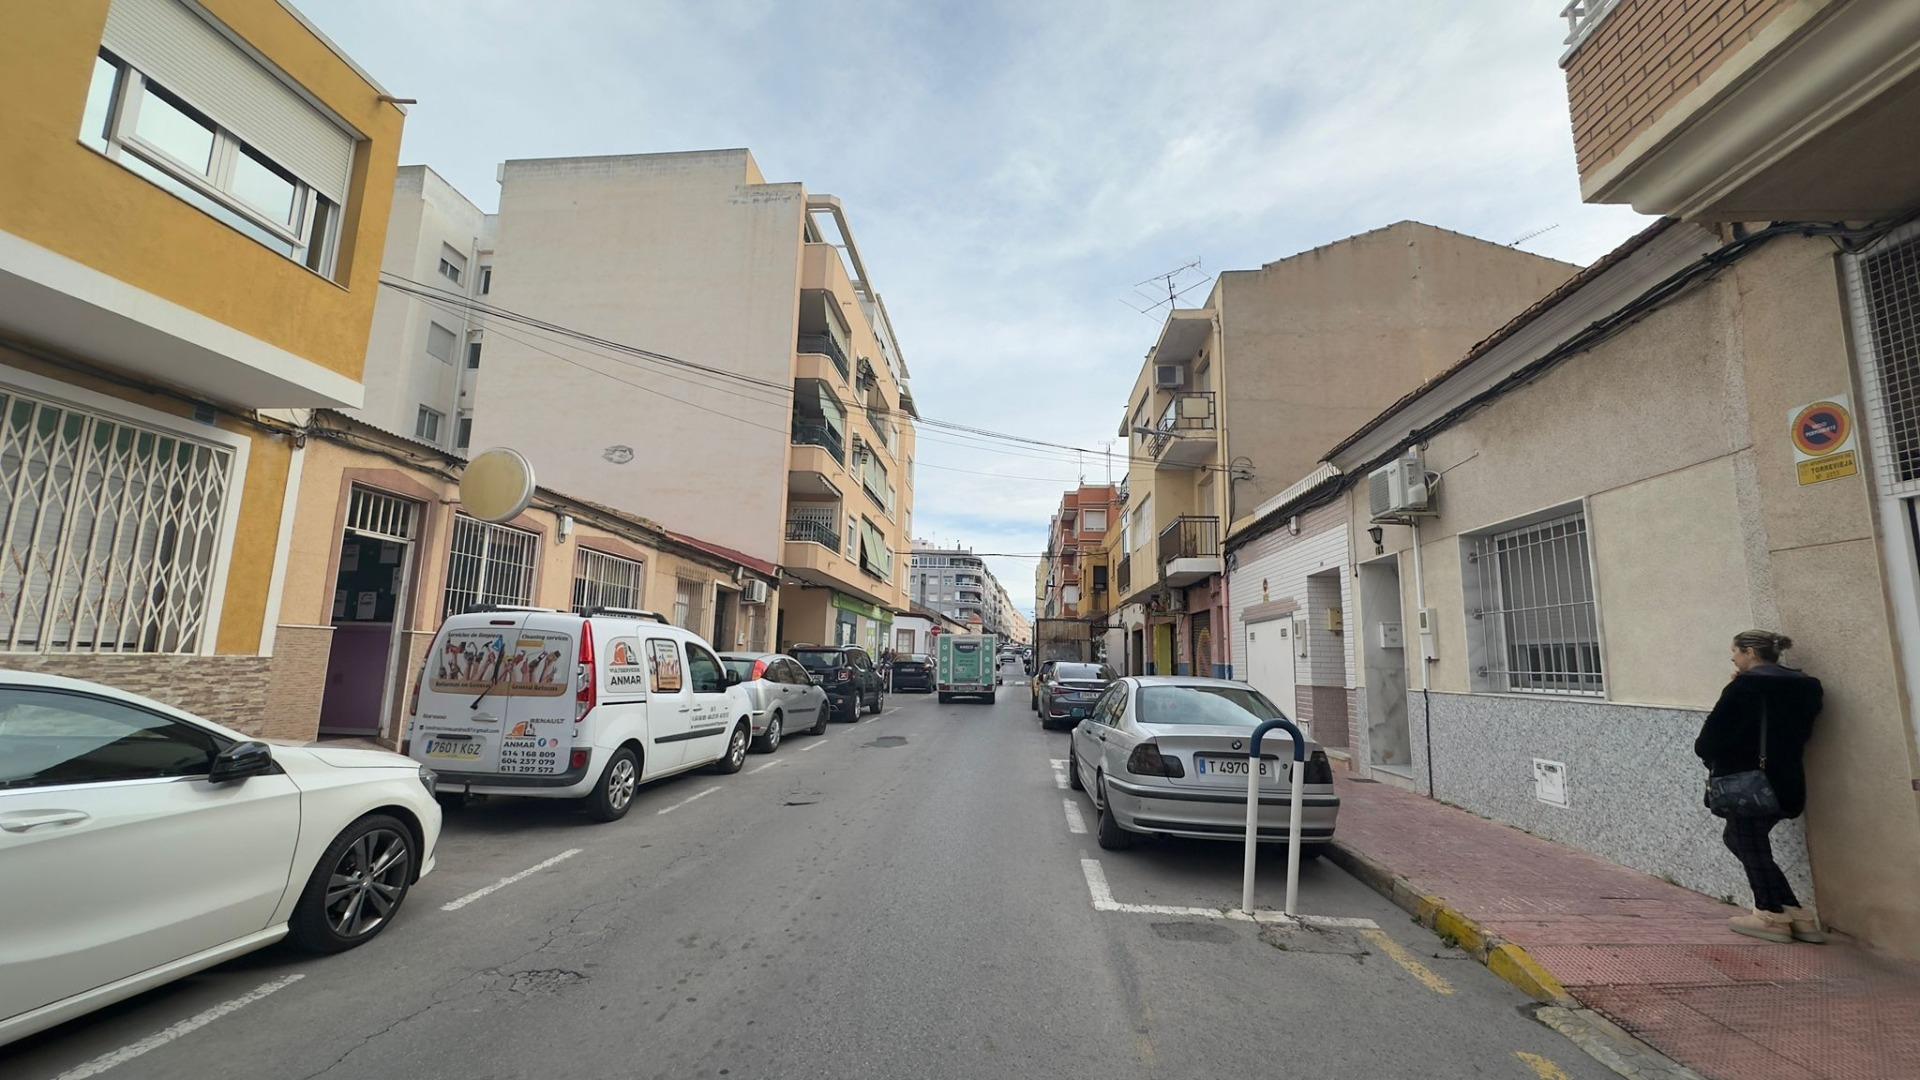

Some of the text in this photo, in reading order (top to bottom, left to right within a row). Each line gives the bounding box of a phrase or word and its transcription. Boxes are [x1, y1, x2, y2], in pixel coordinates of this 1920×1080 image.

[610, 676, 641, 686] ANMAR
[432, 742, 481, 756] 7601 KGZ
[1209, 761, 1216, 773] T
[1220, 761, 1249, 774] 4970
